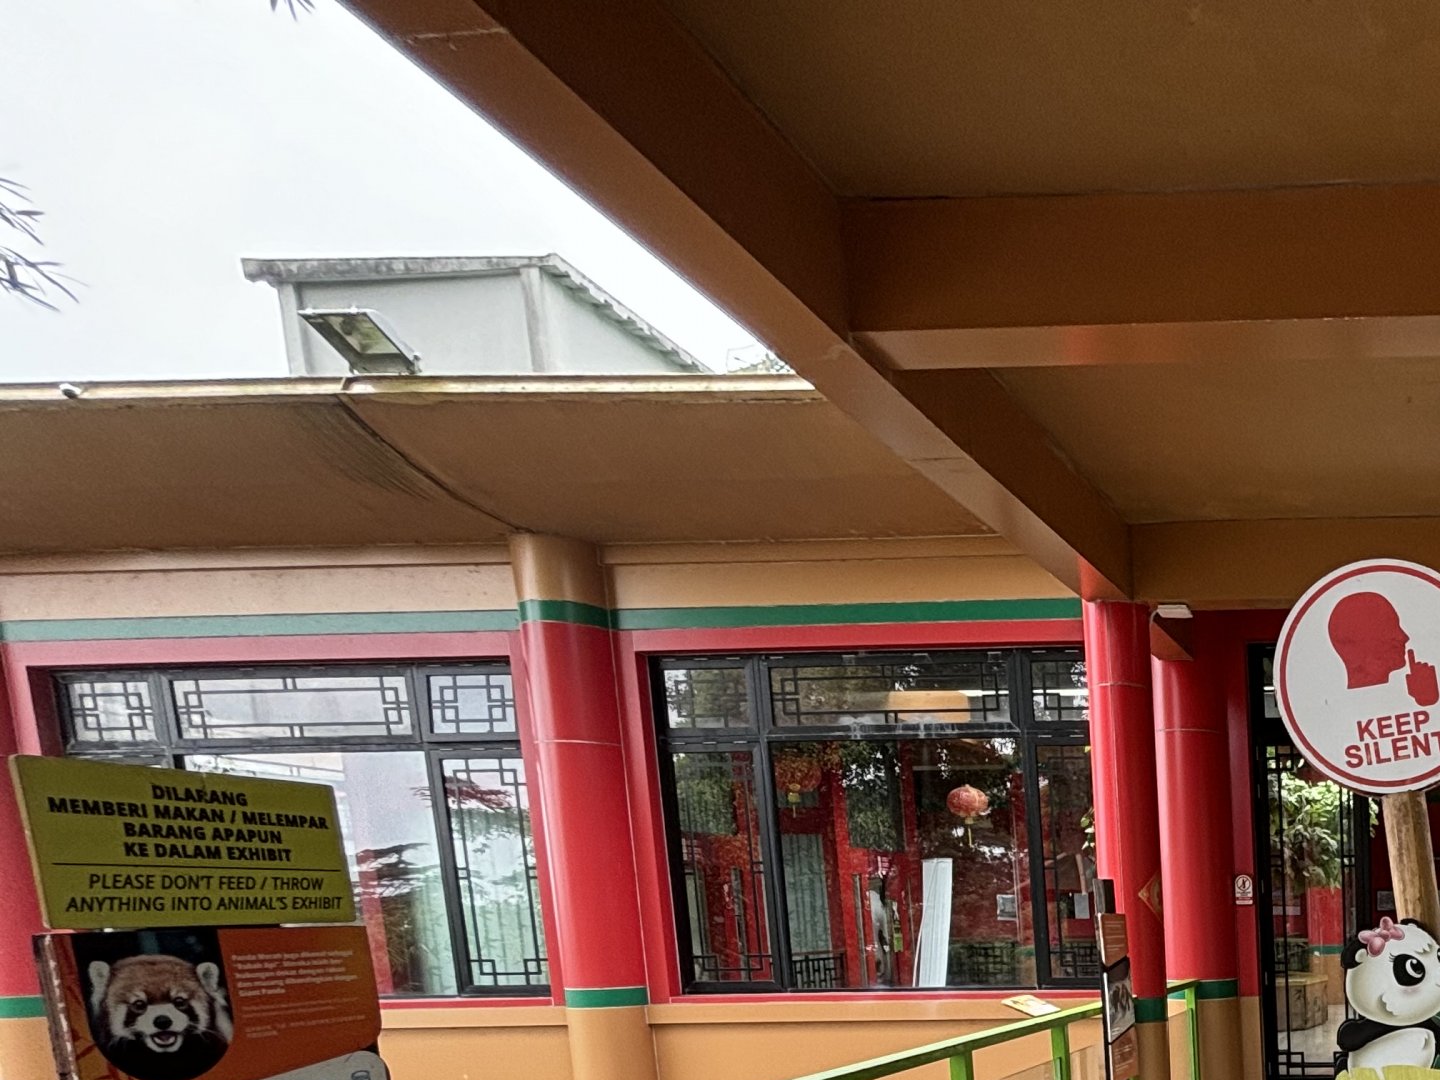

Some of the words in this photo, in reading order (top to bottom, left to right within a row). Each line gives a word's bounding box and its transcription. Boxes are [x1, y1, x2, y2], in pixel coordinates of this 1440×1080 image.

[1357, 710, 1430, 742] KEEP
[48, 797, 148, 818] MEMBERI
[153, 804, 225, 823] MAKAN
[242, 811, 328, 829] MELEMPAR
[123, 822, 206, 840] BARANG
[212, 827, 282, 844] APAPUN
[123, 842, 149, 857] KE
[154, 843, 222, 860] DALAM
[226, 846, 292, 862] EXHIBIT
[89, 873, 155, 889] PLEASE
[161, 875, 214, 890] DON'T
[219, 876, 256, 890] FEED
[271, 877, 323, 890] THROW
[65, 896, 165, 912] ANYTHING
[172, 897, 212, 911] INTO
[216, 896, 287, 911] ANIMAL'S
[292, 896, 342, 910] EXHIBIT
